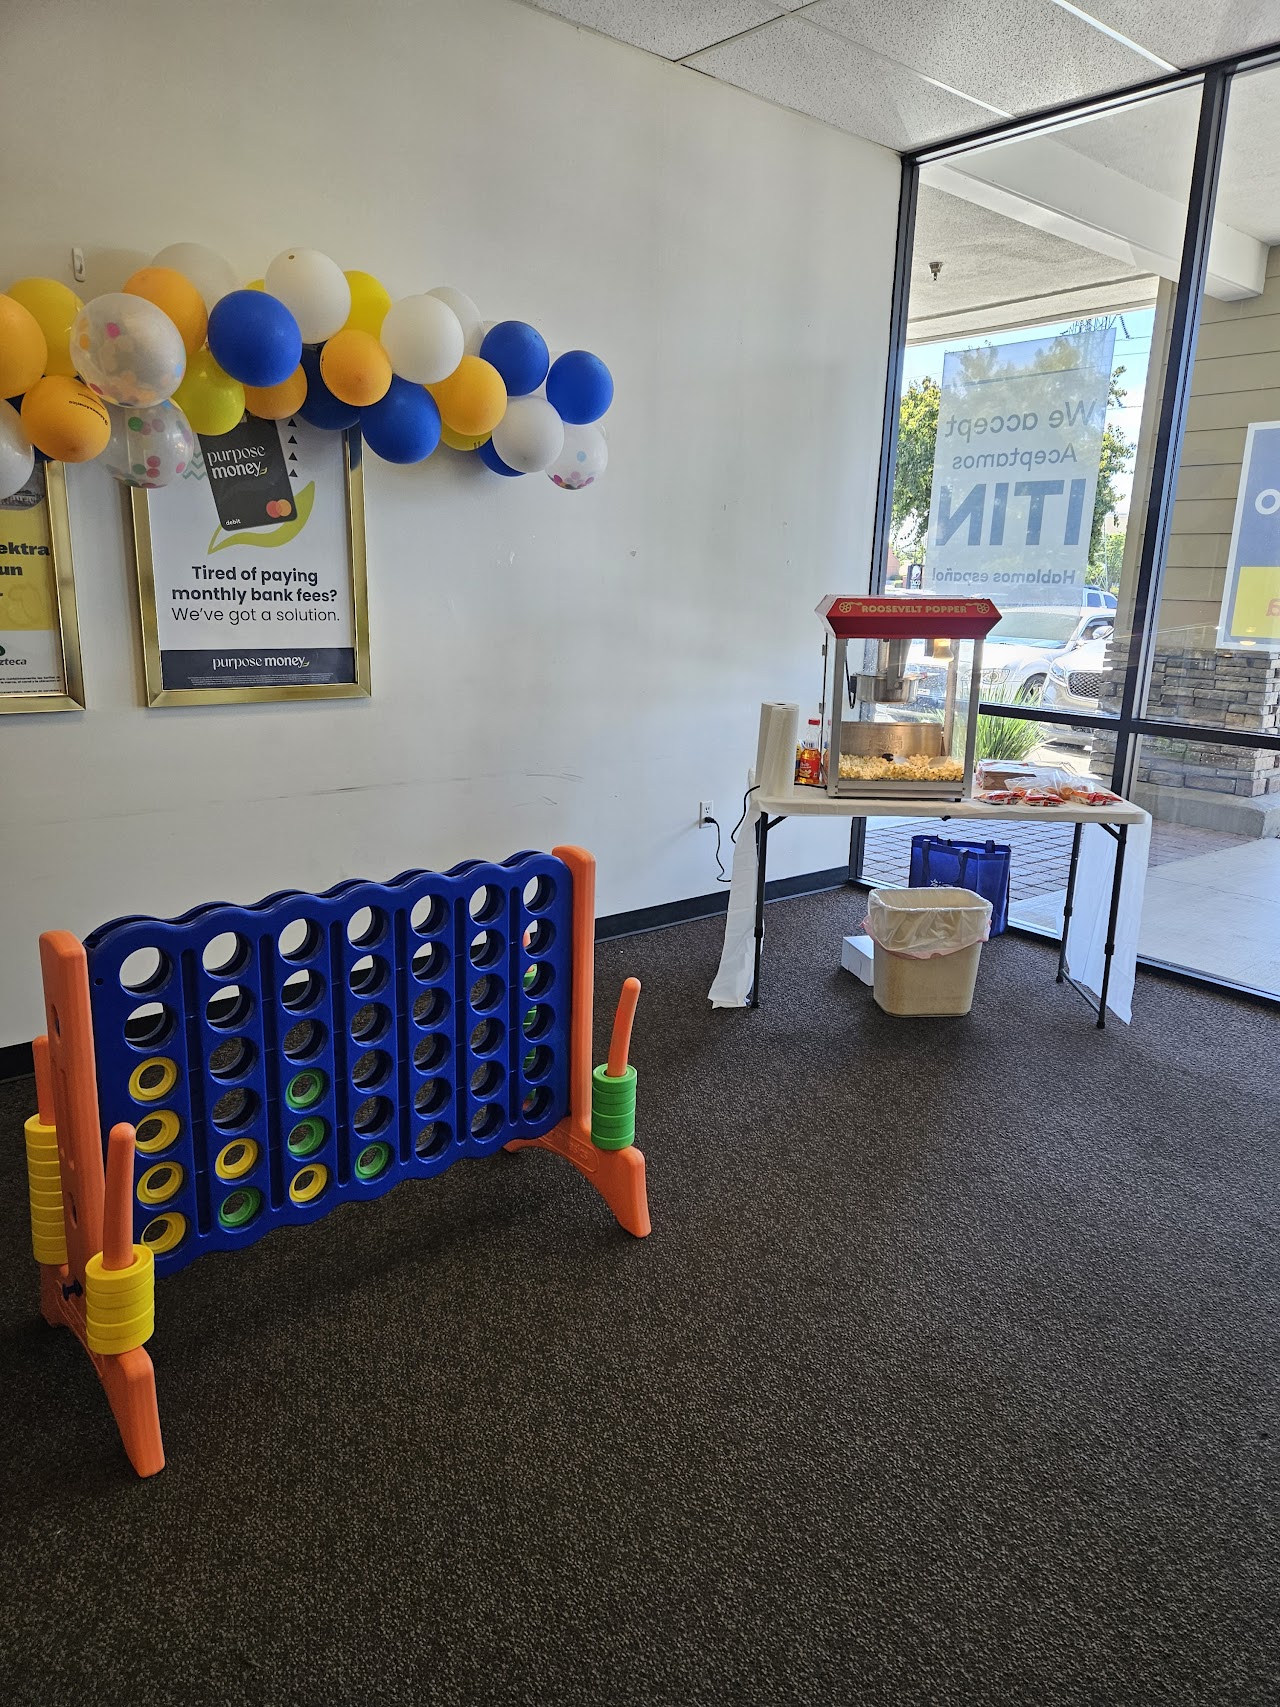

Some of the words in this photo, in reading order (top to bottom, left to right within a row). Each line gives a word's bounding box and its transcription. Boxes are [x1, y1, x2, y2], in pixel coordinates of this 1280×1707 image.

[207, 445, 266, 466] purpose
[211, 461, 262, 480] money
[225, 518, 242, 526] debit
[191, 565, 237, 581] Tired
[240, 567, 258, 581] of
[261, 568, 318, 586] paying
[171, 587, 247, 605] monthly
[251, 588, 294, 602] bank
[297, 588, 338, 602] fees?
[228, 608, 257, 625] got
[261, 610, 271, 621] a
[276, 608, 340, 622] solution.
[861, 605, 923, 614] ROOSEVELT
[925, 605, 967, 614] POPPER
[212, 657, 263, 670] purpose
[264, 656, 305, 669] money
